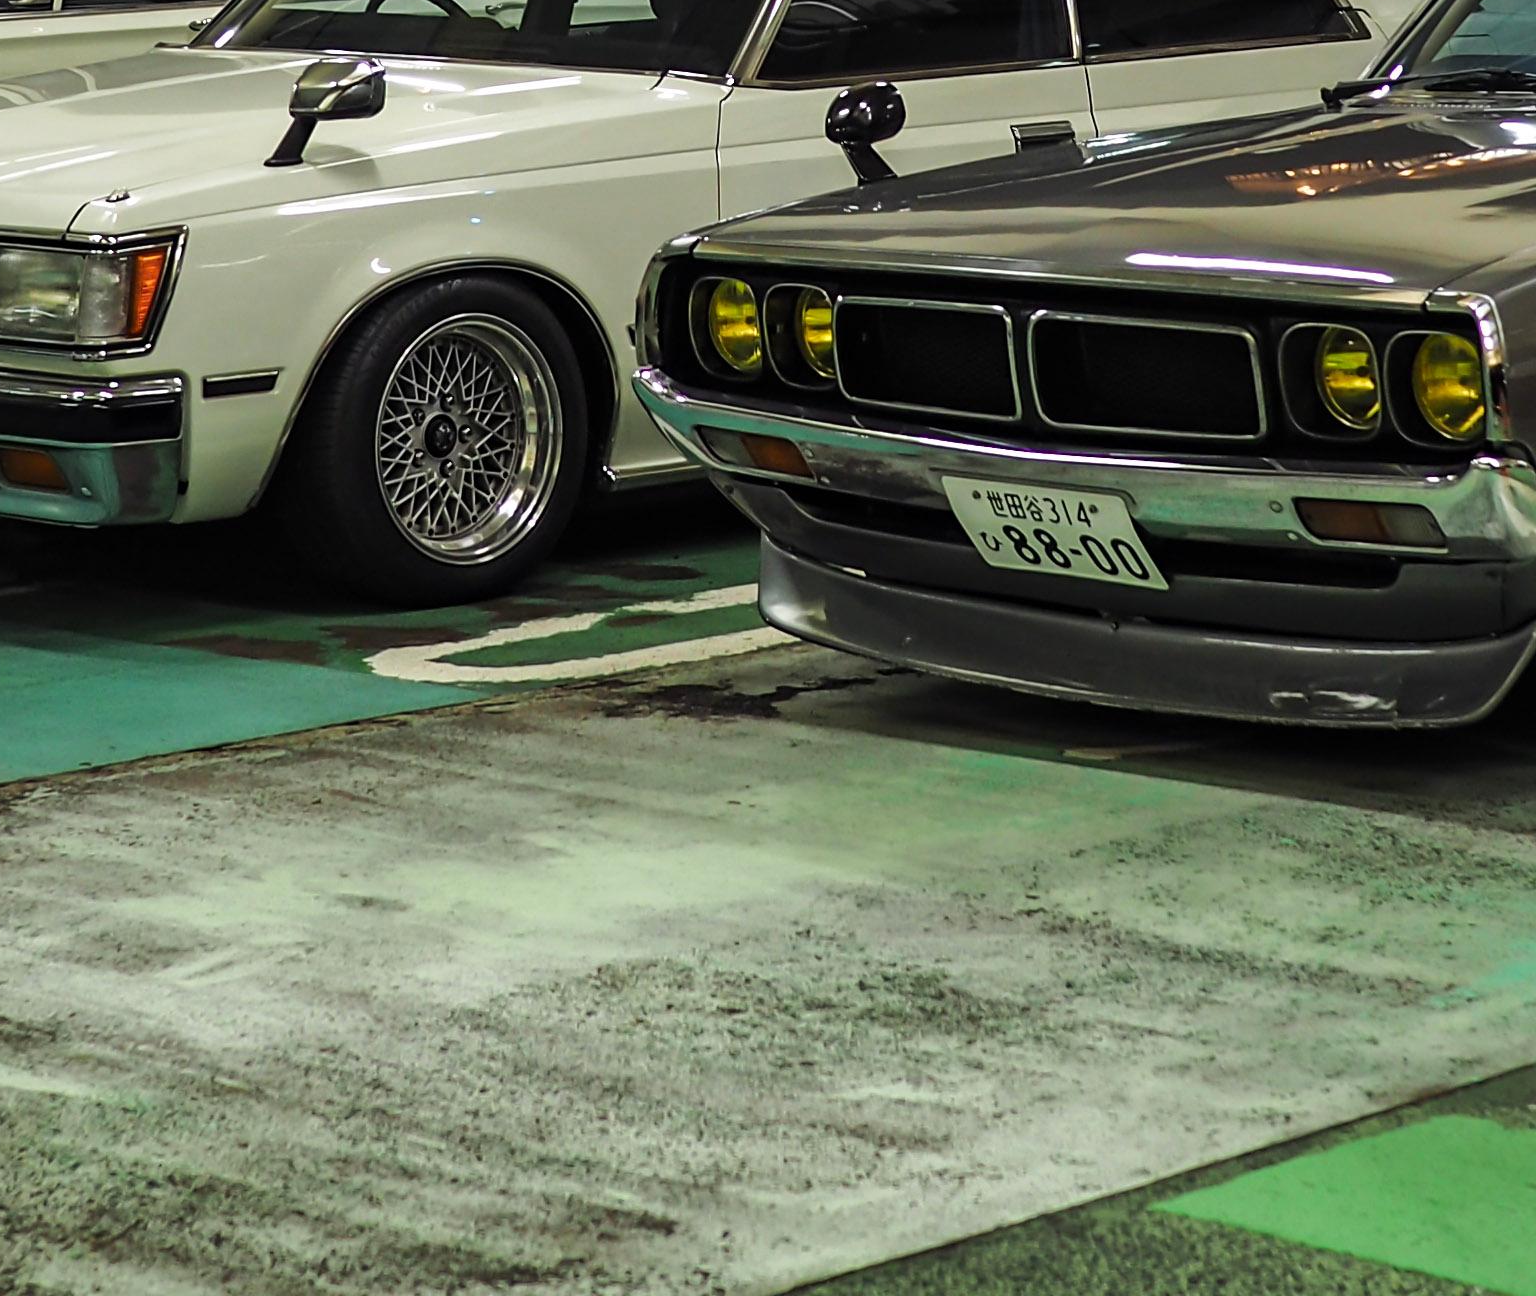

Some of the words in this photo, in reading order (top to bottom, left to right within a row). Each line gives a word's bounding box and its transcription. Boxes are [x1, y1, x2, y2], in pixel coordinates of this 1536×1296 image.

[987, 490, 1092, 528] 世田谷314
[979, 531, 1004, 552] ひ
[1002, 524, 1151, 581] 88-00
